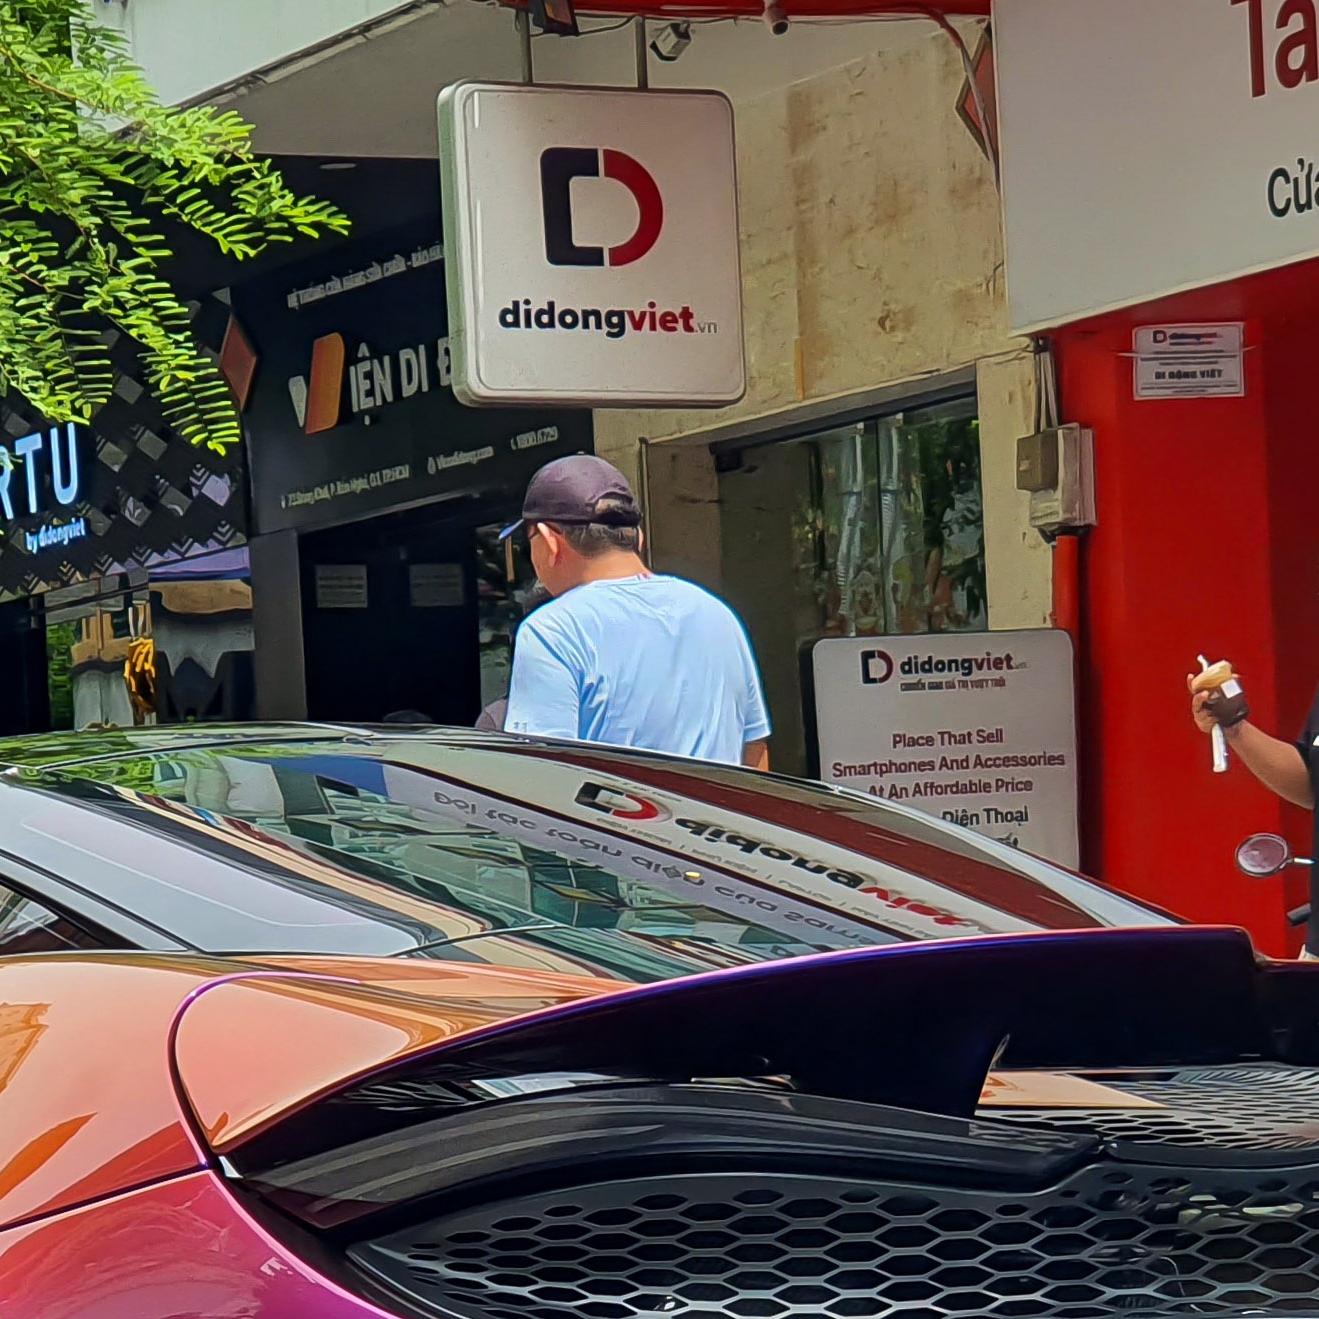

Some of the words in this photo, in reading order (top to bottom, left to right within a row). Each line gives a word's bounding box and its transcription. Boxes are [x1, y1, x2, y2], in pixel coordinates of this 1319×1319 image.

[399, 344, 429, 397] DI
[892, 732, 935, 748] Place
[937, 730, 972, 747] That
[976, 728, 1004, 744] Sell
[832, 758, 935, 778] Smartphones
[938, 755, 970, 771] And
[973, 751, 1066, 769] Accessories
[888, 784, 909, 800] An
[912, 779, 992, 797] Affordable
[995, 778, 1034, 793] Price
[983, 805, 1029, 827] Thoại
